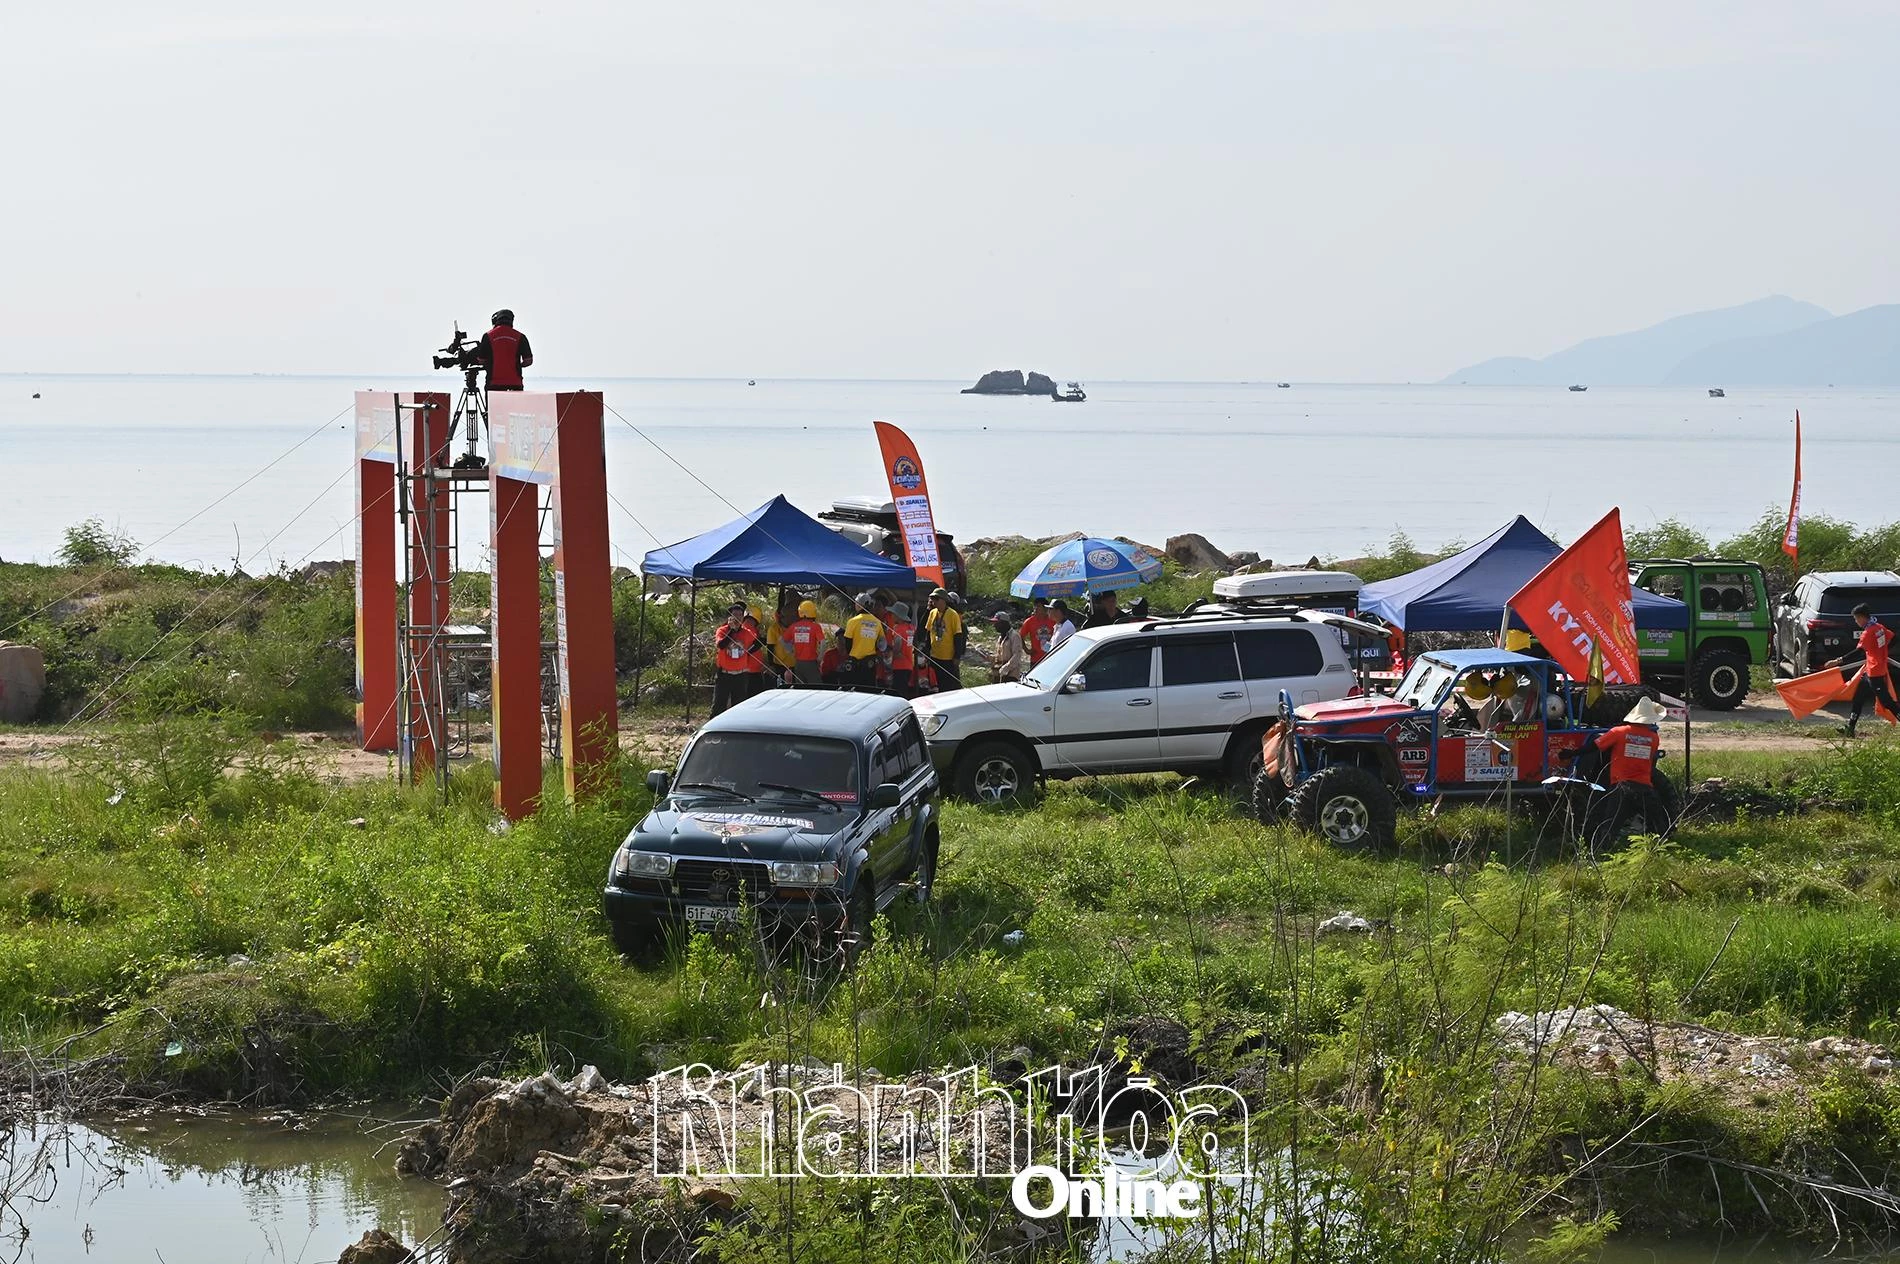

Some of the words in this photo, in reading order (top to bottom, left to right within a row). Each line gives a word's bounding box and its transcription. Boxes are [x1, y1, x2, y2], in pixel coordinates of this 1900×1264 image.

[1582, 609, 1598, 629] FROM
[1595, 625, 1616, 652] PASSION
[1612, 645, 1623, 659] TO
[1402, 750, 1426, 761] ARB
[740, 813, 815, 830] CHALLENGE
